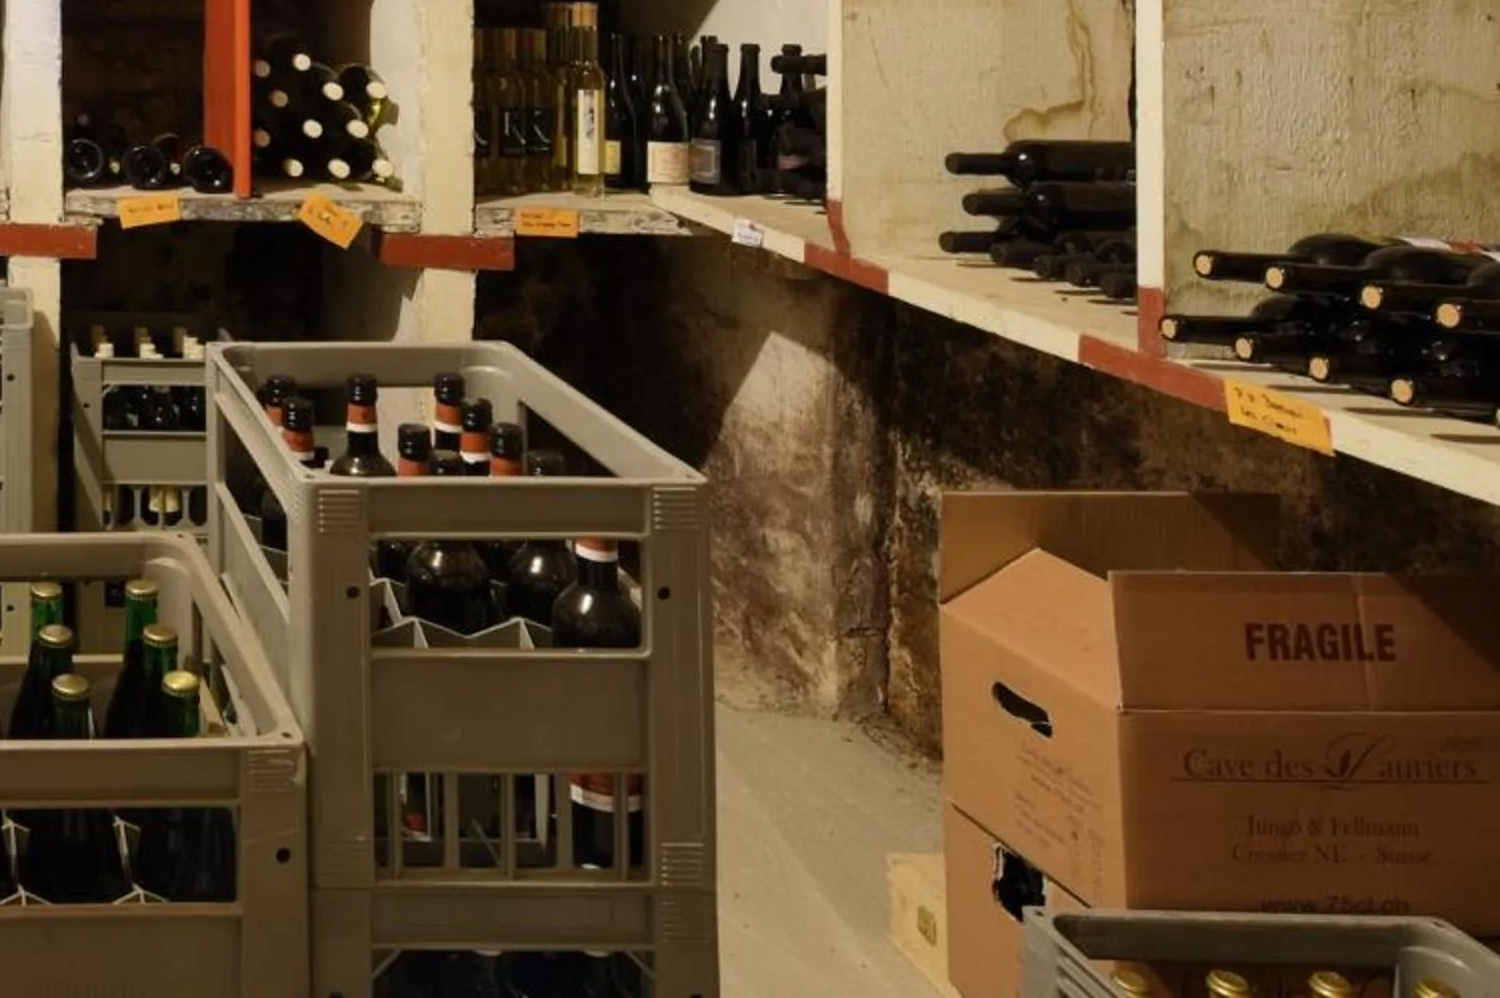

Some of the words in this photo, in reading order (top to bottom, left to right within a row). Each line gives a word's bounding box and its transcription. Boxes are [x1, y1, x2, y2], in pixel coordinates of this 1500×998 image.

[1245, 623, 1397, 662] FRAGILE
[1183, 748, 1253, 778] Cave
[1266, 748, 1314, 778] des
[1307, 816, 1322, 837] &
[1329, 814, 1420, 838] Fellmann
[1314, 842, 1347, 864] NE
